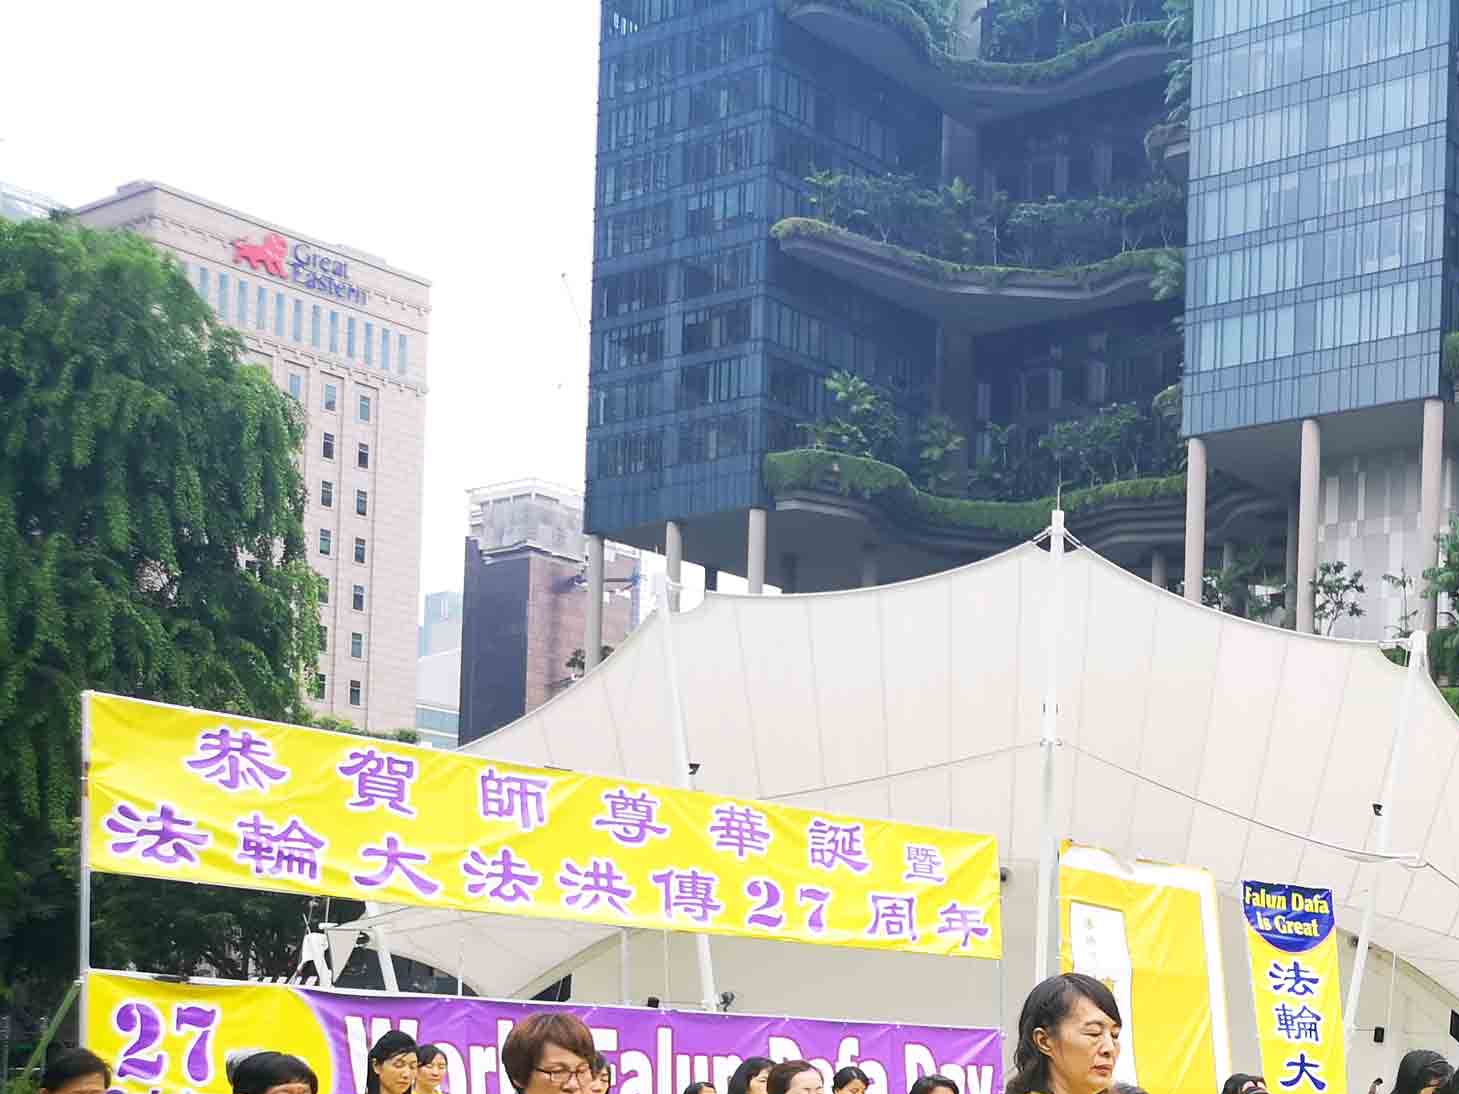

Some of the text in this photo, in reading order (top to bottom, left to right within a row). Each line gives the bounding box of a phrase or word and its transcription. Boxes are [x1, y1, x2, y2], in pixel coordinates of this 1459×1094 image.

[295, 242, 350, 280] Great
[292, 262, 368, 305] Eastern
[1245, 885, 1330, 914] Falun Dafa
[1274, 915, 1319, 937] Great
[115, 1002, 217, 1083] 27
